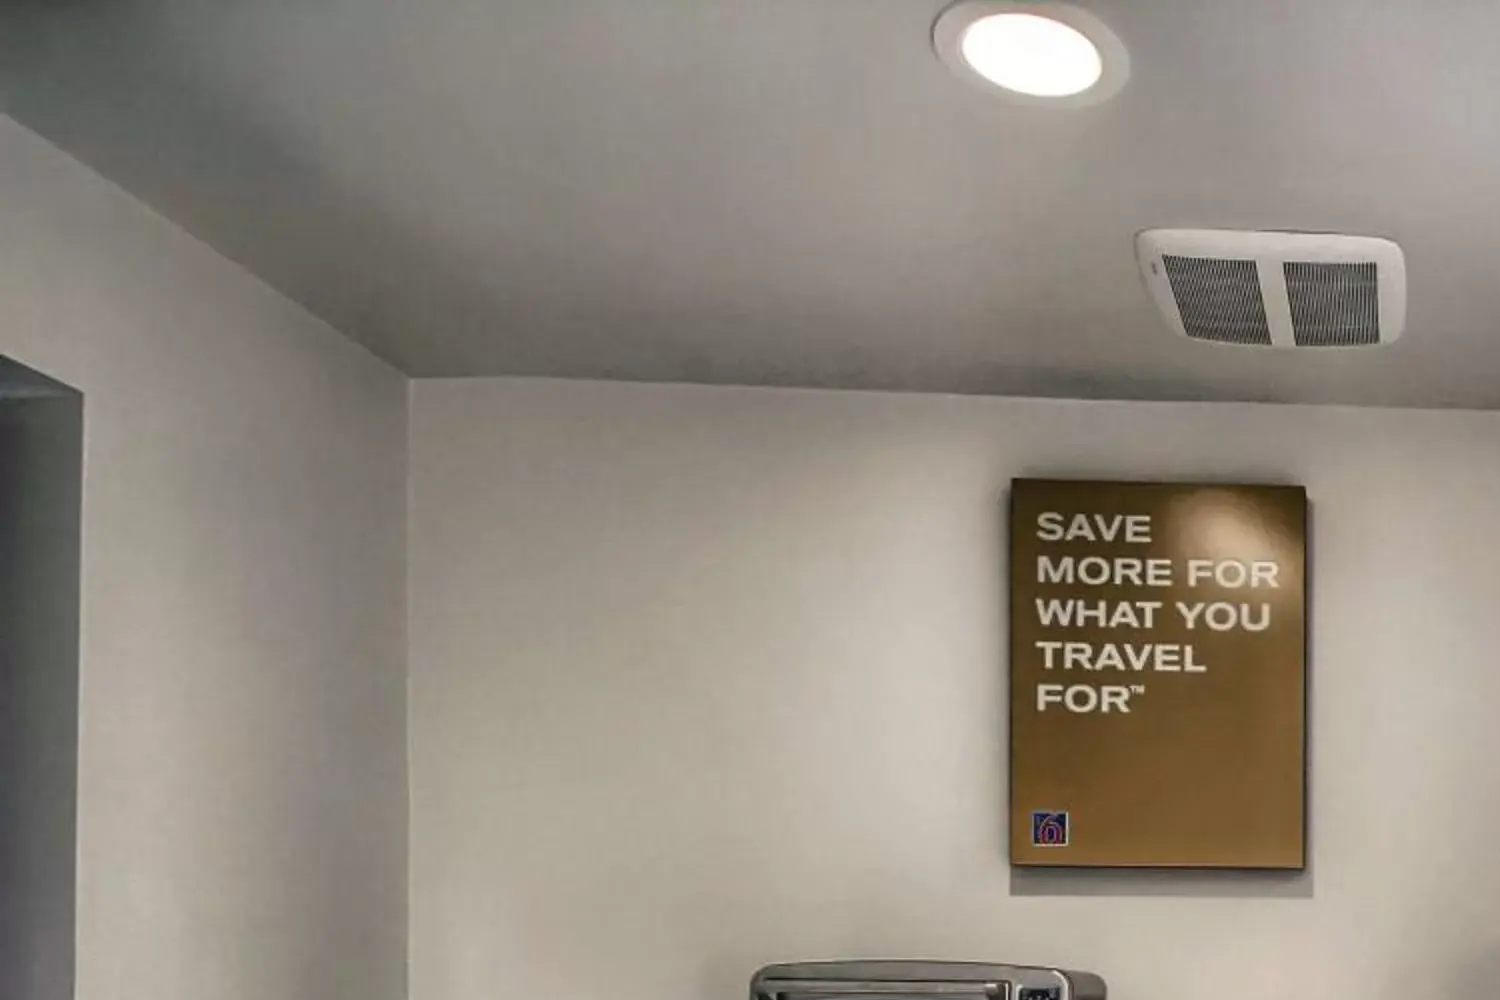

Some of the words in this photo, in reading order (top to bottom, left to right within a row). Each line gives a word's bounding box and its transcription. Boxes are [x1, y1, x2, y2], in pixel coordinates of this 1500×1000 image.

[1036, 511, 1152, 543] SAVE
[1037, 555, 1173, 587] MORE
[1187, 559, 1280, 589] FOR
[1035, 598, 1163, 629] WHAT
[1175, 602, 1271, 632] YOU
[1035, 641, 1207, 673] TRAVEL
